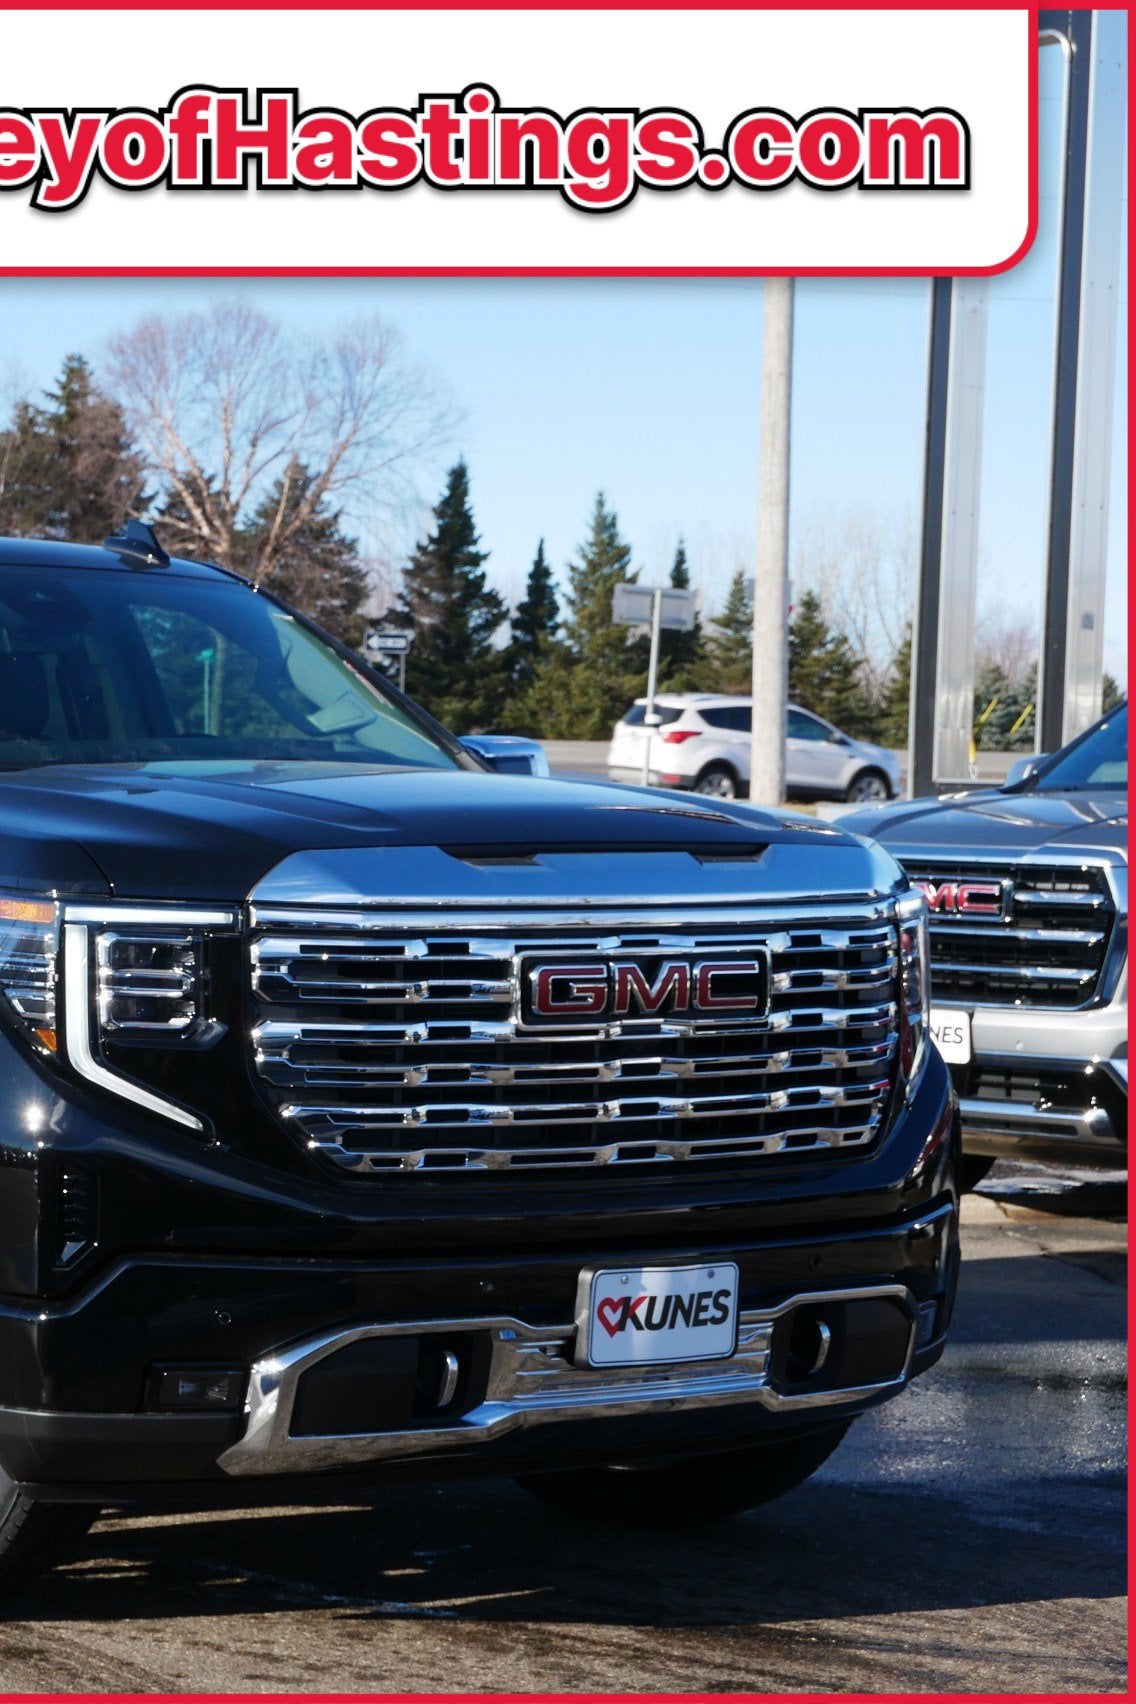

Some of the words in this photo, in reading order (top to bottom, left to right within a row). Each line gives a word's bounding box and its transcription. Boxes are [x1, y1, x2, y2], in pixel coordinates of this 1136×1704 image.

[909, 881, 1000, 914] MC
[532, 960, 760, 1016] GMC
[617, 1288, 732, 1332] KUNES
